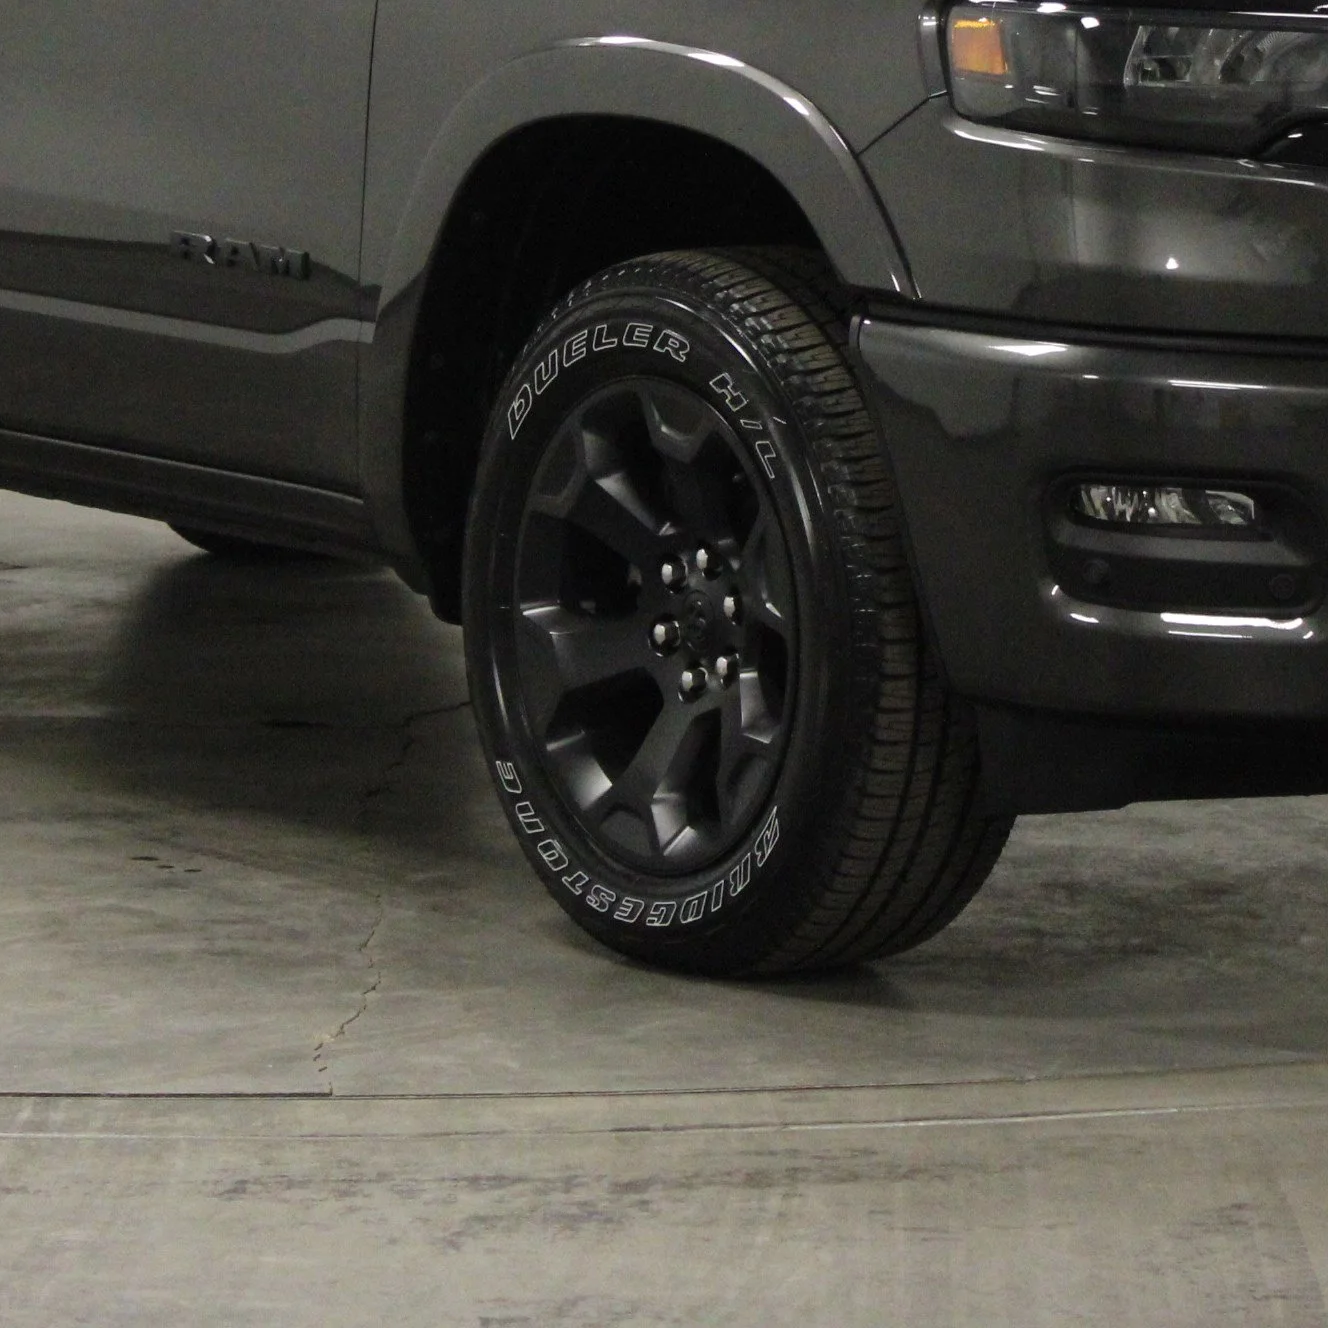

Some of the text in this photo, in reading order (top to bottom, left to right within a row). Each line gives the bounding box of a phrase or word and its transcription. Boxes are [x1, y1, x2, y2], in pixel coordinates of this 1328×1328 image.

[171, 229, 311, 281] RAM
[508, 321, 692, 441] DUELER
[495, 758, 780, 928] BRIDGESTONE
